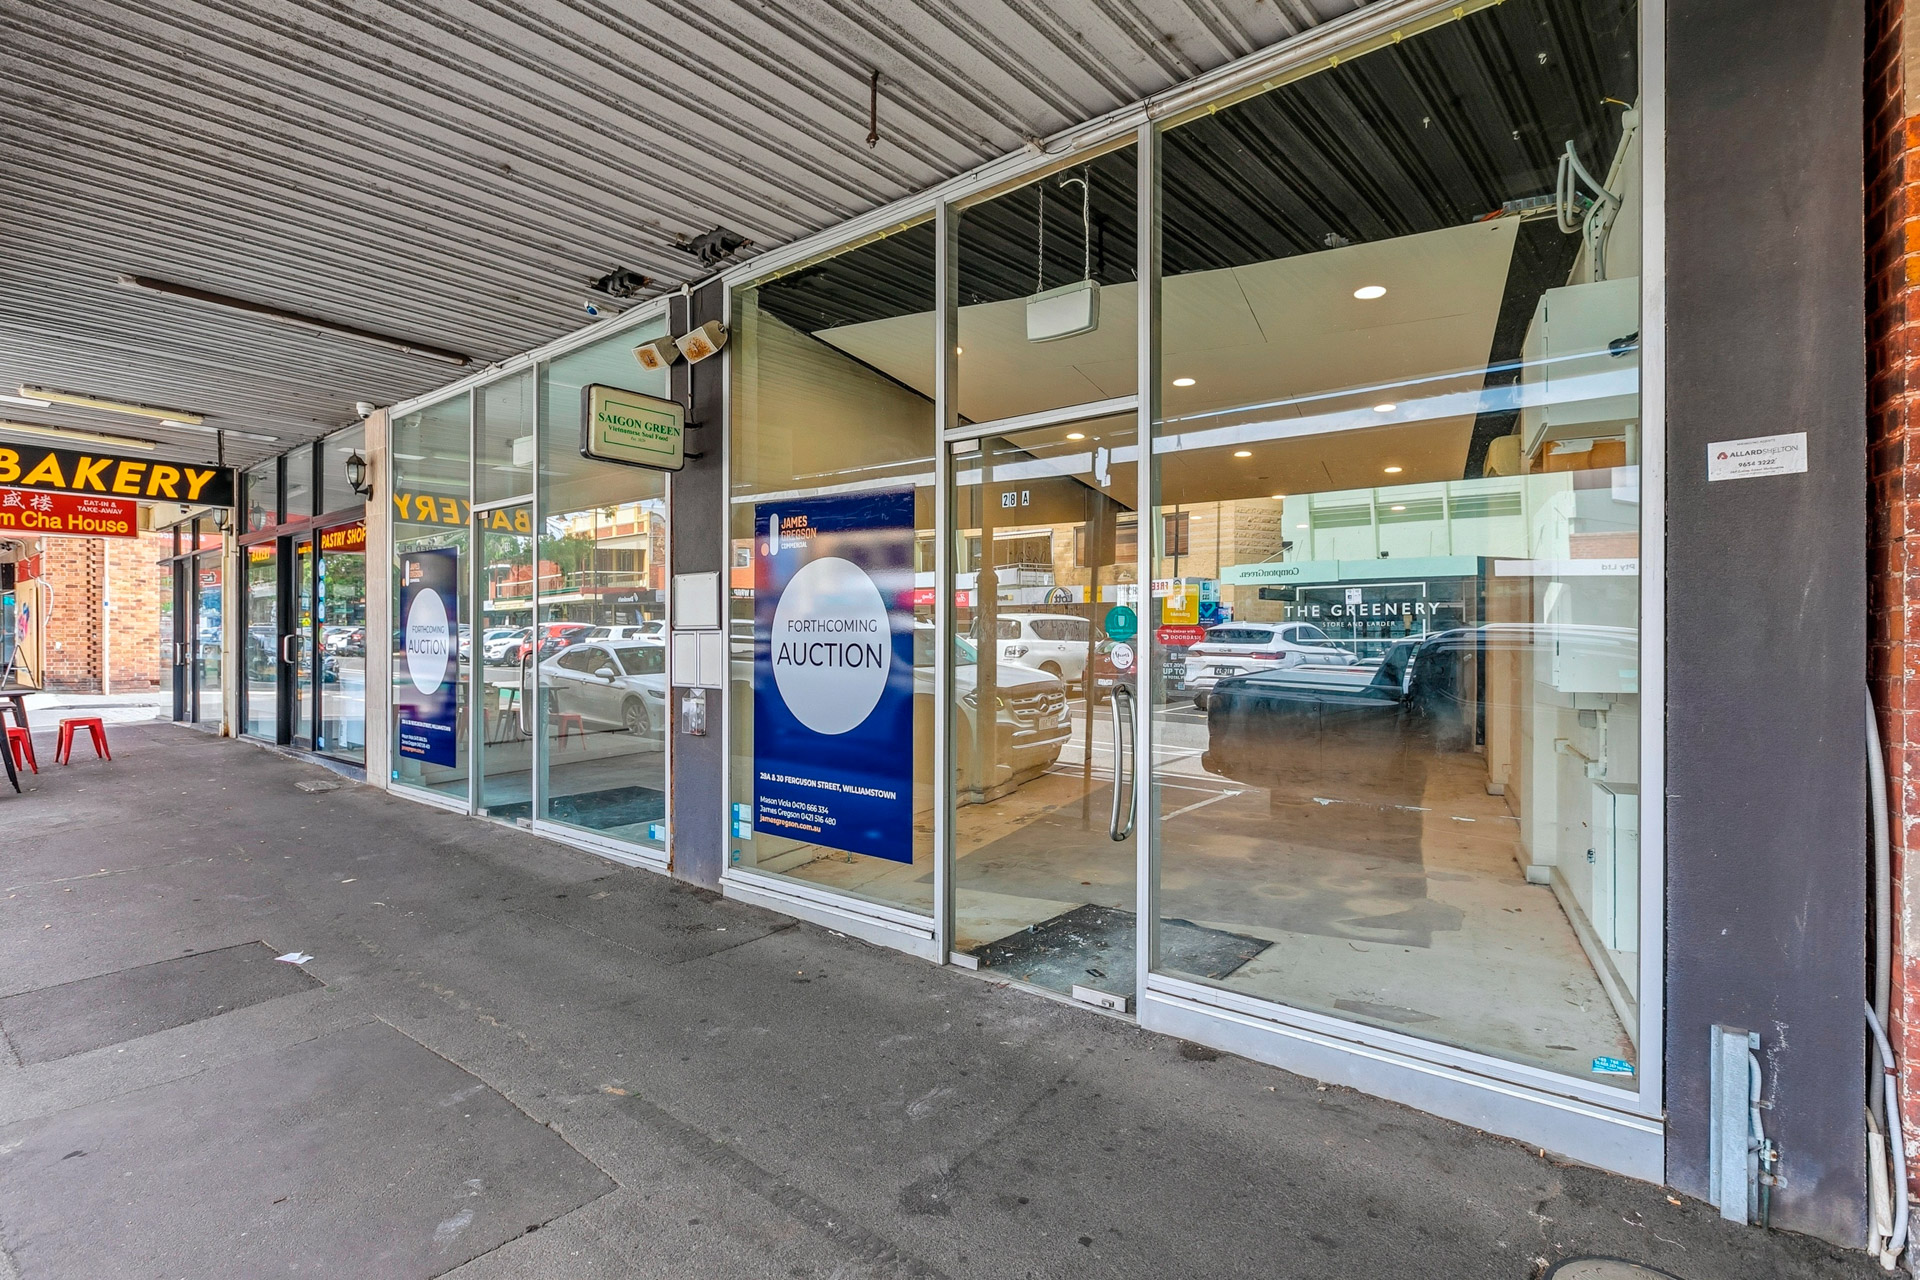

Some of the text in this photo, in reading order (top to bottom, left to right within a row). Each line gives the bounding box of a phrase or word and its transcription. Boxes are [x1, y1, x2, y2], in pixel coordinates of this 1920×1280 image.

[598, 411, 681, 437] SAIGON GREEN
[608, 424, 641, 436] Vietnamese
[641, 431, 654, 440] Soul
[654, 434, 669, 442] Food
[0, 448, 217, 500] BAKERY
[83, 499, 109, 508] EAT-IN
[1002, 491, 1029, 507] 28 A
[77, 505, 124, 515] TAKE-AWAY
[21, 510, 63, 530] Cha
[68, 514, 129, 534] House
[781, 515, 808, 530] JAMES
[321, 530, 346, 549] PASTRY
[780, 527, 818, 542] GREGSON
[781, 541, 808, 550] COMMERCIAL
[1284, 602, 1441, 617] THE GREENERY
[412, 625, 445, 634] FORTHCOMING
[787, 619, 878, 633] FORTHCOMING
[408, 639, 447, 655] AUCTION
[776, 642, 882, 669] AUCTION
[772, 774, 776, 782] &
[784, 776, 817, 788] FERGUSON
[817, 781, 842, 793] STREET,
[842, 784, 897, 800] WILLIAMSTOWN
[760, 796, 829, 815] Mason Viola 0470 666 334
[760, 804, 777, 814] James
[778, 807, 801, 820] Gregson
[801, 811, 814, 822] 0421
[814, 814, 824, 824] 516
[824, 816, 837, 826] 480
[760, 815, 822, 833] jamesgregson.com.au
